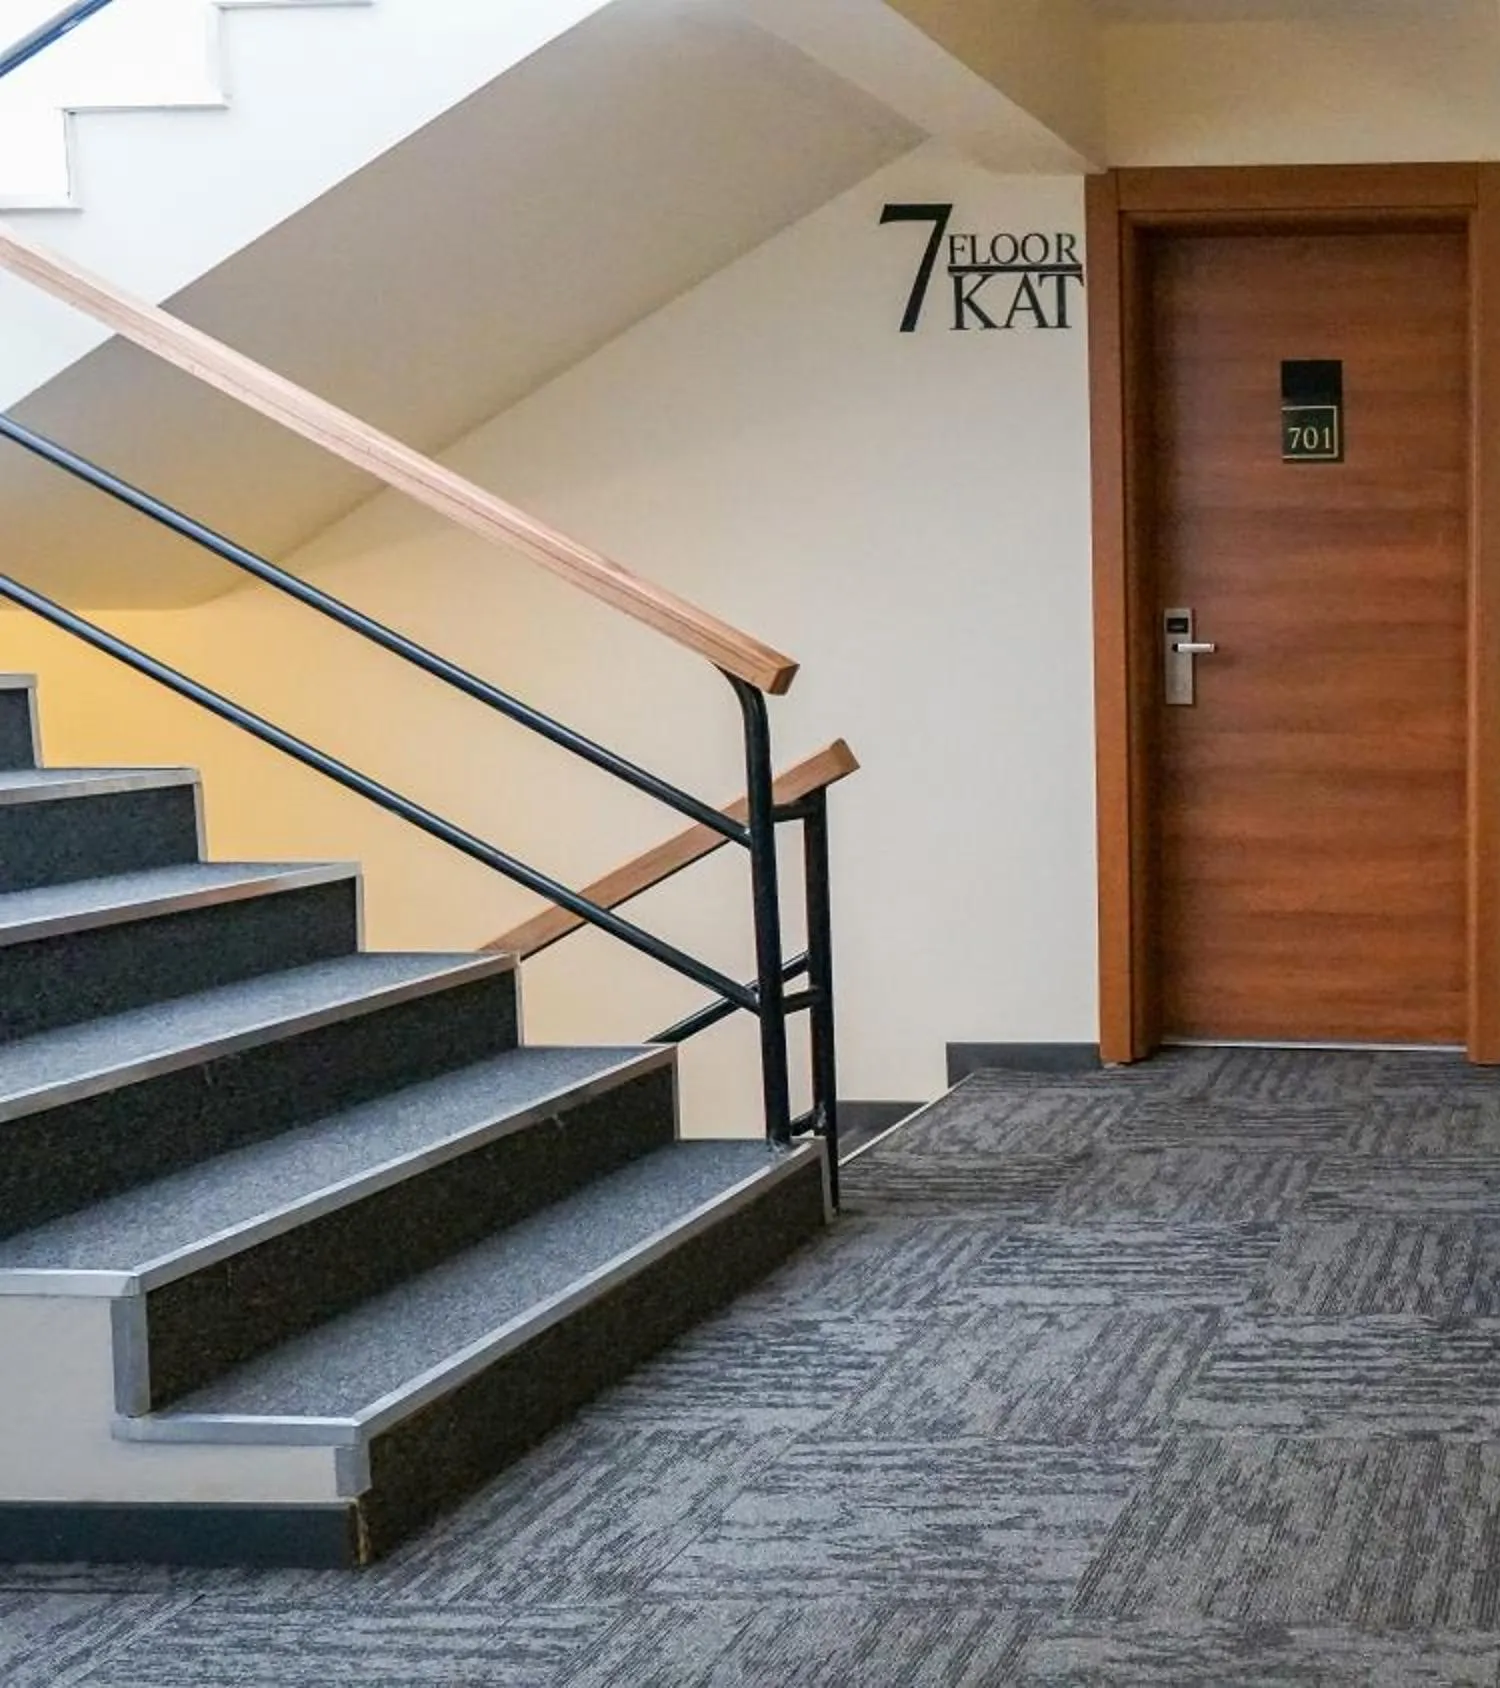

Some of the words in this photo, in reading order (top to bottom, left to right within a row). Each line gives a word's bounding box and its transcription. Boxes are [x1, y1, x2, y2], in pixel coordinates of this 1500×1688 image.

[880, 204, 952, 332] 7
[949, 233, 1080, 264] FLOOR
[950, 272, 1084, 330] KAT
[1287, 427, 1331, 449] 701
